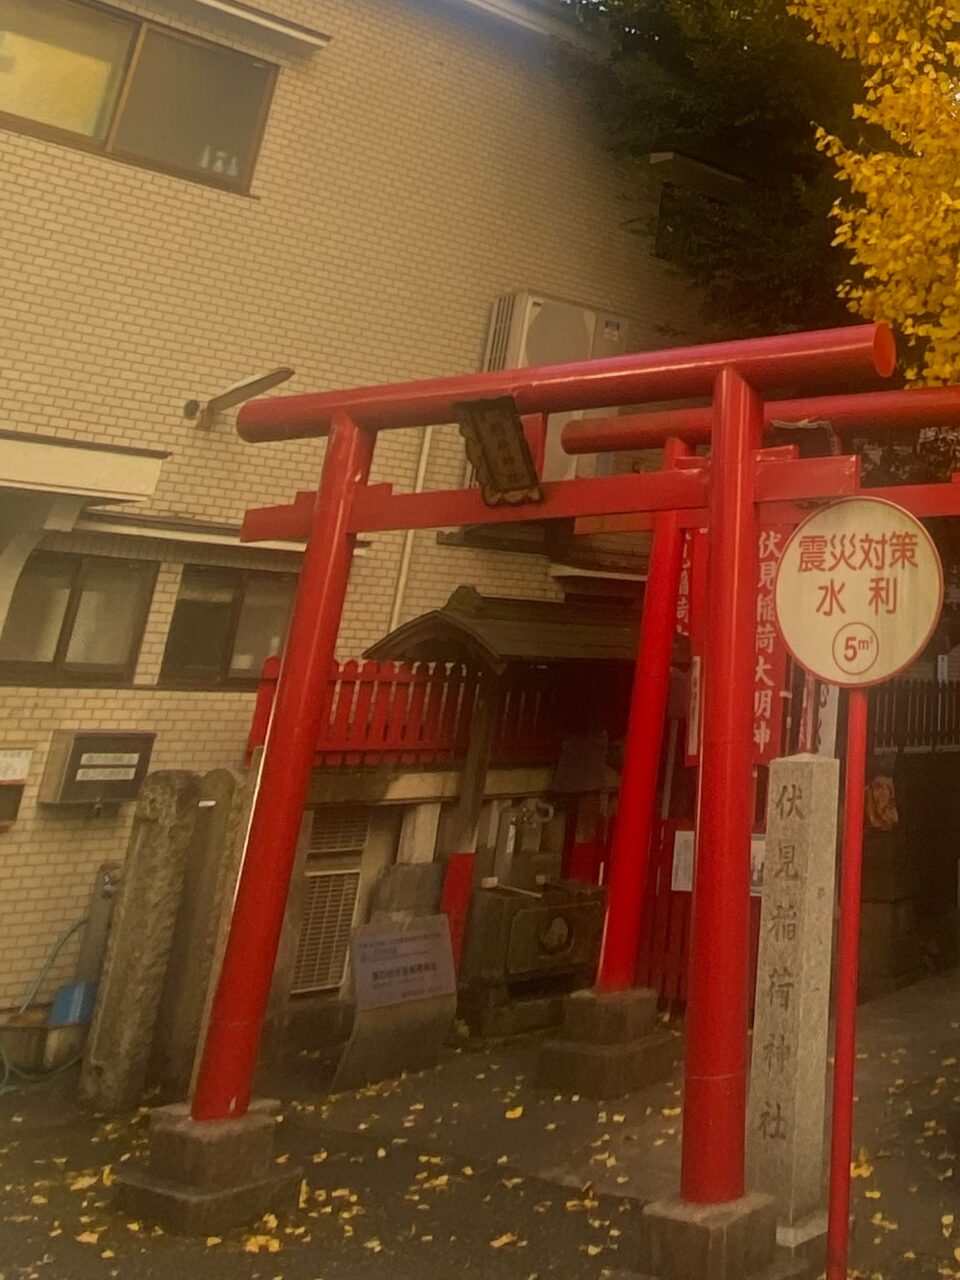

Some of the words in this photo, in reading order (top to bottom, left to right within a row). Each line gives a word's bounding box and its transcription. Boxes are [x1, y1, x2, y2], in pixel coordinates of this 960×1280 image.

[798, 531, 918, 573] 震災対策
[816, 575, 898, 617] 水利
[757, 783, 805, 1141] 伏見稲荷神社
